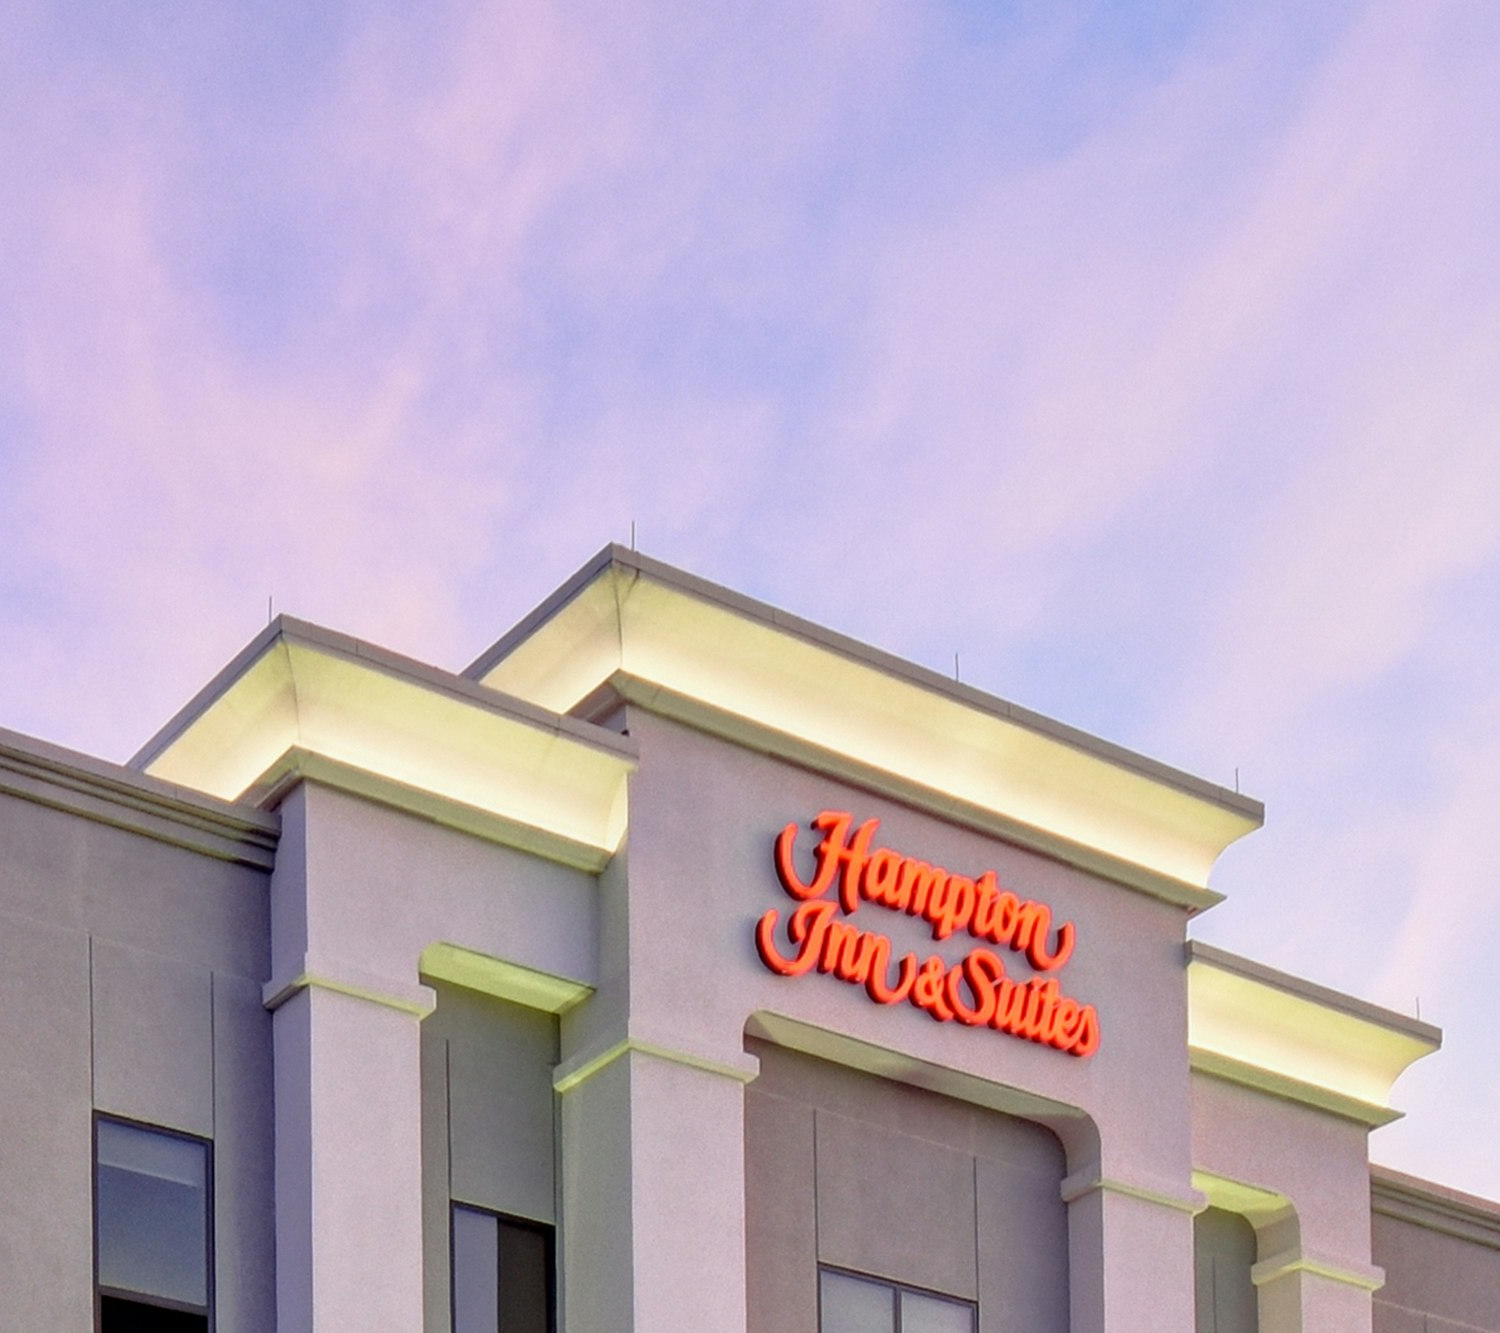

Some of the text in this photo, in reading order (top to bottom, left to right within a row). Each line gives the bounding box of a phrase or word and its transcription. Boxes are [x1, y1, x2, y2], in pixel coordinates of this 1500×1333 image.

[773, 810, 1076, 972] Hampton
[755, 901, 1100, 1057] Inn & Suites
